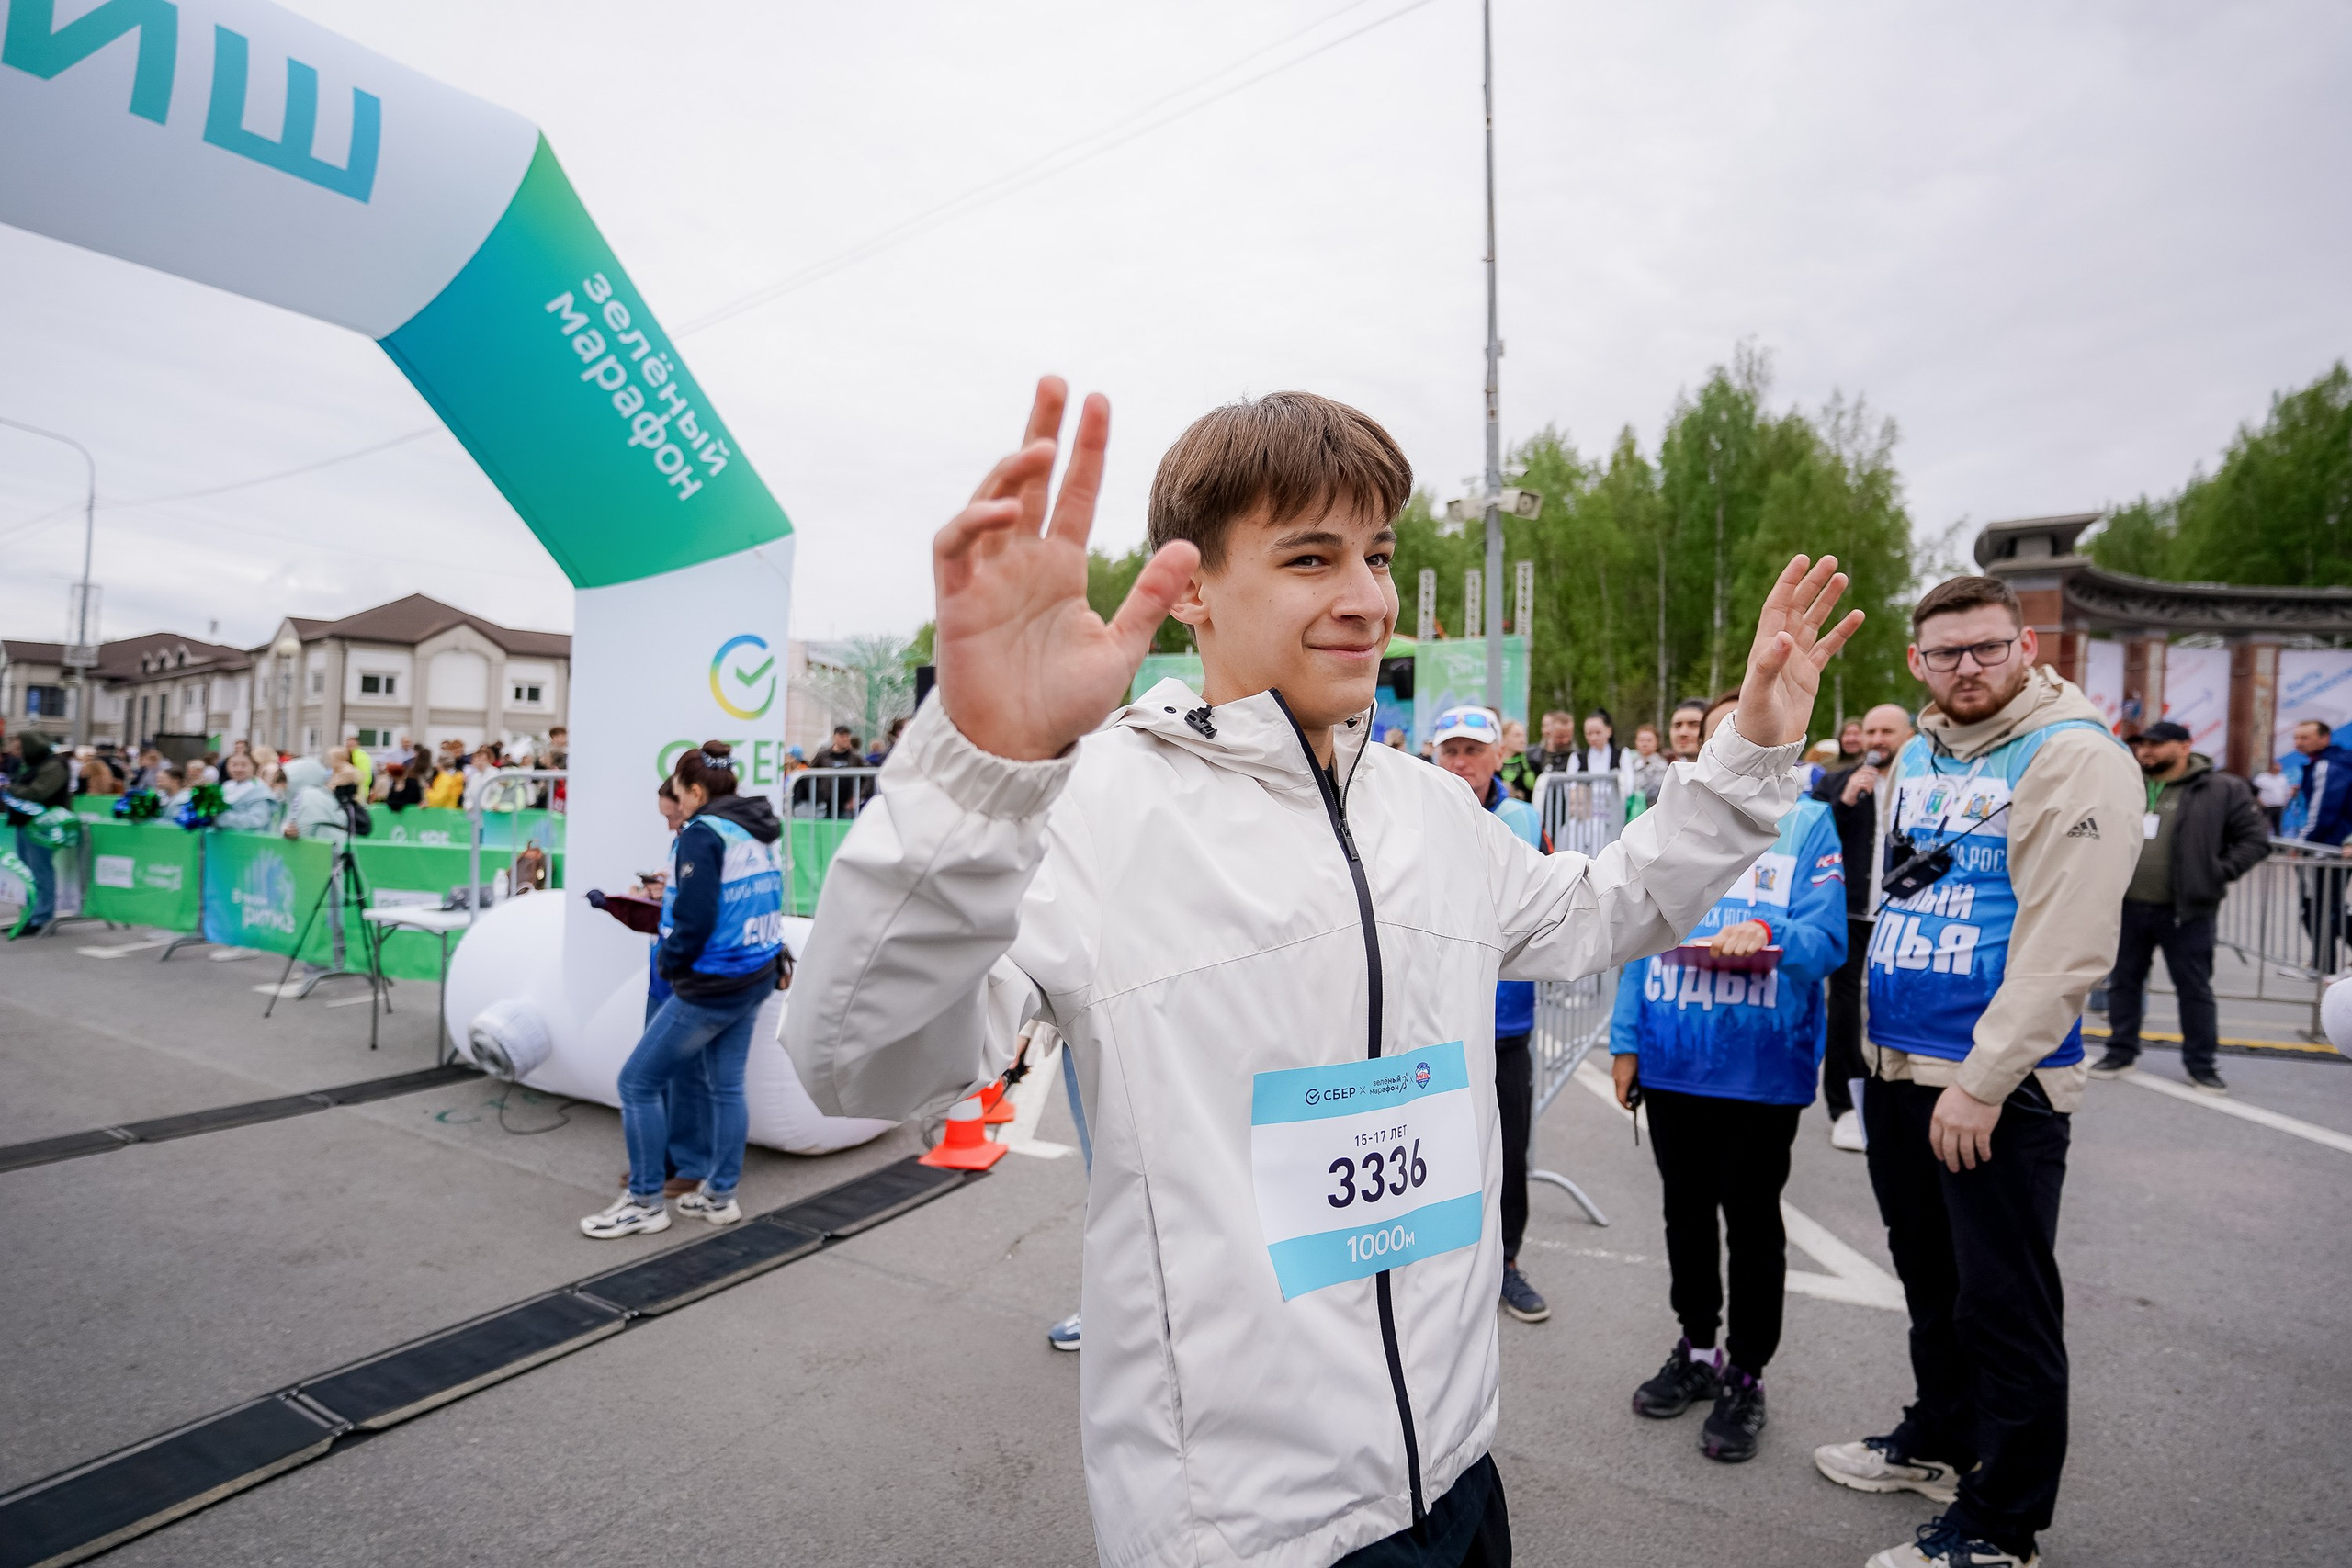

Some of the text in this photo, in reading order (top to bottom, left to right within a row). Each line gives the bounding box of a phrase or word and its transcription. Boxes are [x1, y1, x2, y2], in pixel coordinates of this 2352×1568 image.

[582, 272, 730, 478] зелёный
[545, 290, 702, 502] марафон
[1968, 845, 2009, 873] РОС
[1723, 907, 1753, 927] ЮГР
[1868, 908, 1981, 976] ДЬЯ
[1369, 1085, 1400, 1096] марафон
[1373, 1074, 1402, 1087] зелёный
[1323, 1087, 1356, 1101] СБЕР
[1354, 1123, 1408, 1147] 15-17 ЛЕТ
[1327, 1137, 1427, 1208] 3336
